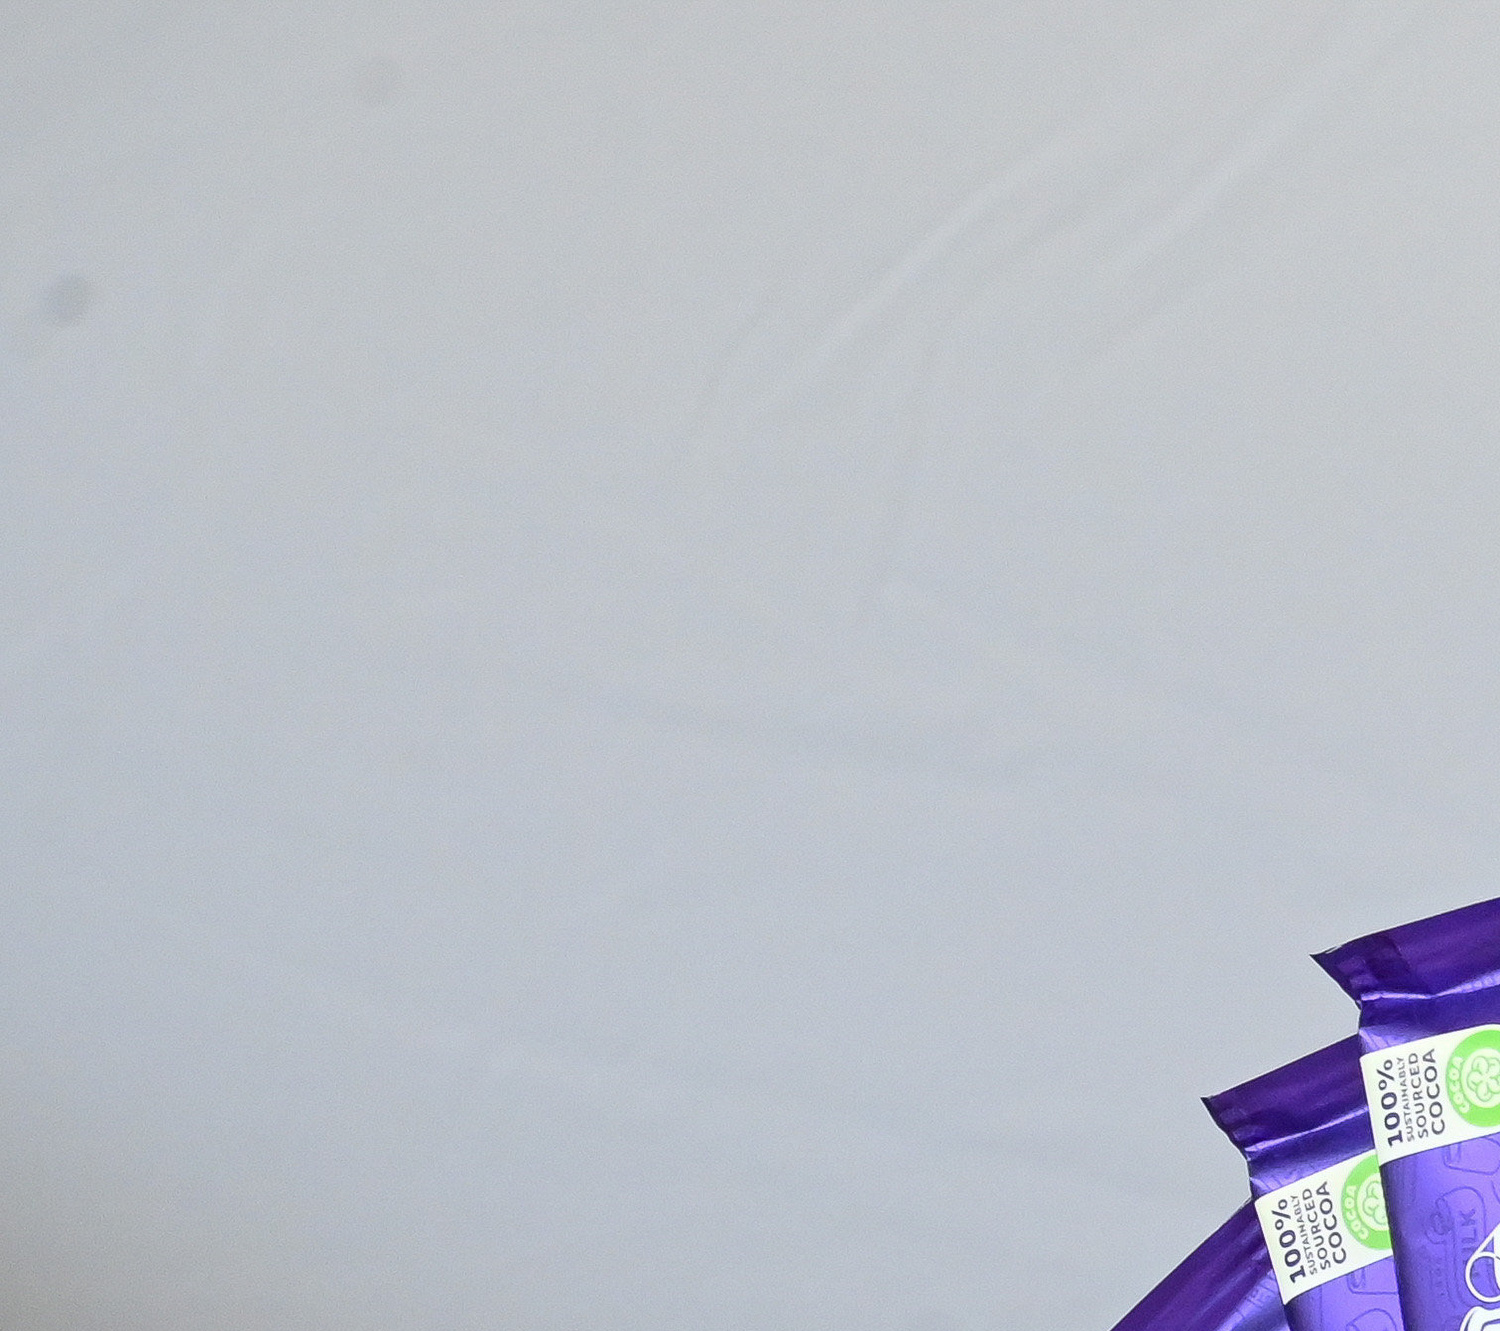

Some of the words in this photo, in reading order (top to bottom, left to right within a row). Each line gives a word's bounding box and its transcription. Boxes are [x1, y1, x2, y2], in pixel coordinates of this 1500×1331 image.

[1376, 1059, 1403, 1148] 100%
[1397, 1057, 1415, 1142] SUSTAINABLY
[1409, 1053, 1429, 1139] SOURCED
[1423, 1048, 1445, 1135] COCOA
[1449, 1056, 1470, 1114] COCOA
[1271, 1198, 1306, 1283] 100%
[1290, 1194, 1318, 1275] SUSTAINABLY
[1302, 1188, 1331, 1270] SOURCED
[1316, 1181, 1347, 1264] COCOA
[1345, 1185, 1369, 1240] COCOA
